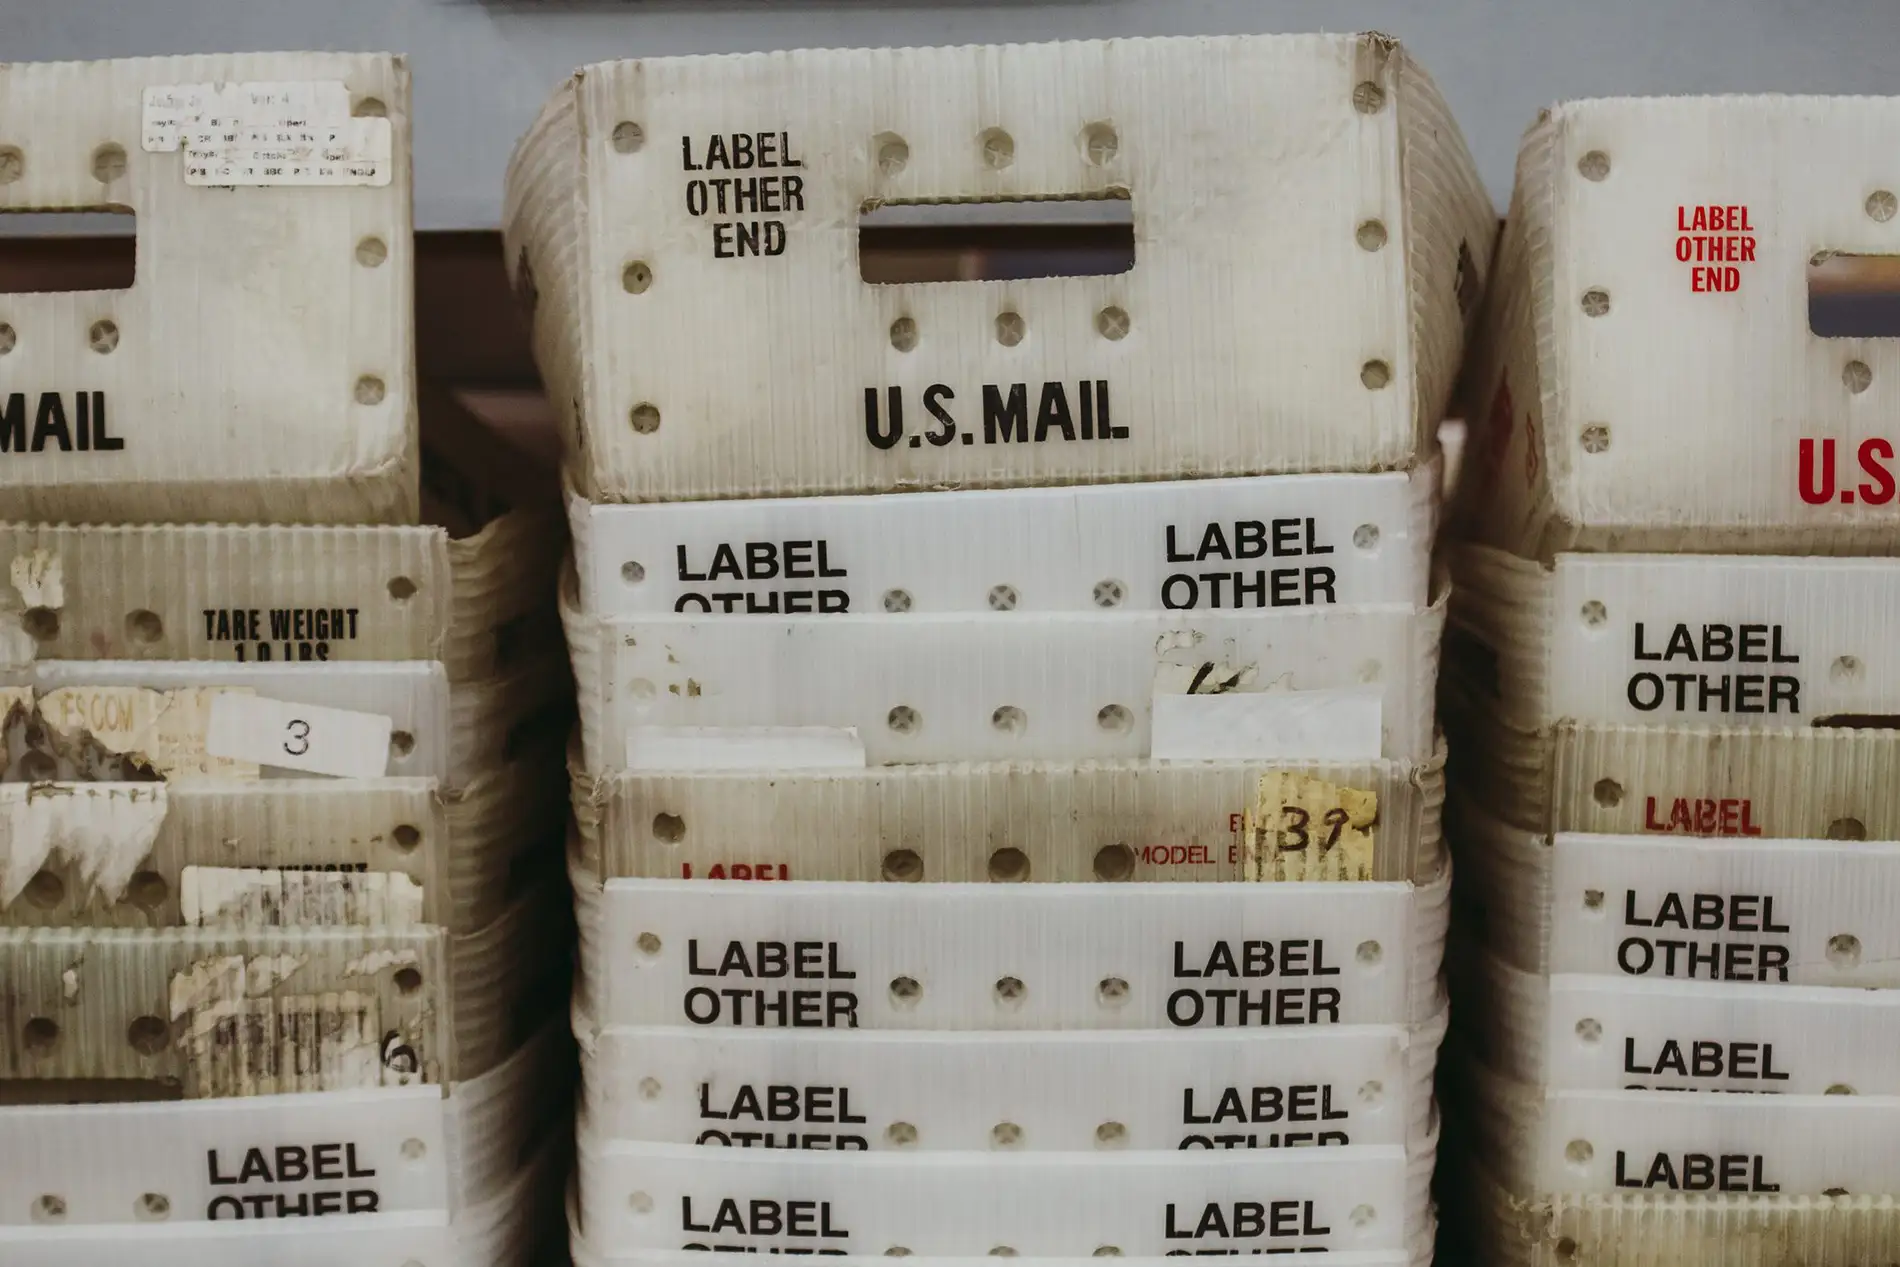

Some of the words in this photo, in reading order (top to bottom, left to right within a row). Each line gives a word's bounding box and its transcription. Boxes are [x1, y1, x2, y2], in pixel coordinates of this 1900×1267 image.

[683, 131, 803, 170] LABEL
[686, 175, 805, 217] OTHER
[713, 220, 786, 259] END
[1677, 205, 1754, 233] LABEL
[1675, 235, 1757, 264] OTHER
[1690, 265, 1741, 294] END
[1798, 437, 1900, 506] U.S
[676, 539, 848, 582] LABEL
[1166, 517, 1335, 563] LABEL
[1161, 566, 1337, 610] OTHER
[202, 609, 261, 641] TARE
[269, 608, 360, 641] WEIGHT
[1634, 622, 1800, 664] LABEL
[1627, 672, 1801, 714] OTHER
[283, 718, 311, 756] 3
[1645, 796, 1762, 836] LABEL
[1625, 889, 1790, 933] LABEL
[688, 939, 857, 979] LABEL
[1173, 939, 1341, 978] LABEL
[1617, 937, 1790, 983] OTHER
[684, 986, 860, 1028] OTHER
[1166, 987, 1341, 1027] OTHER
[1624, 1037, 1790, 1080] LABEL
[700, 1082, 867, 1124] LABEL
[1183, 1084, 1349, 1124] LABEL
[207, 1142, 376, 1185] LABEL
[1615, 1150, 1781, 1193] LABEL
[207, 1189, 380, 1221] OTHER
[682, 1196, 849, 1238] LABEL
[1165, 1200, 1331, 1239] LABEL
